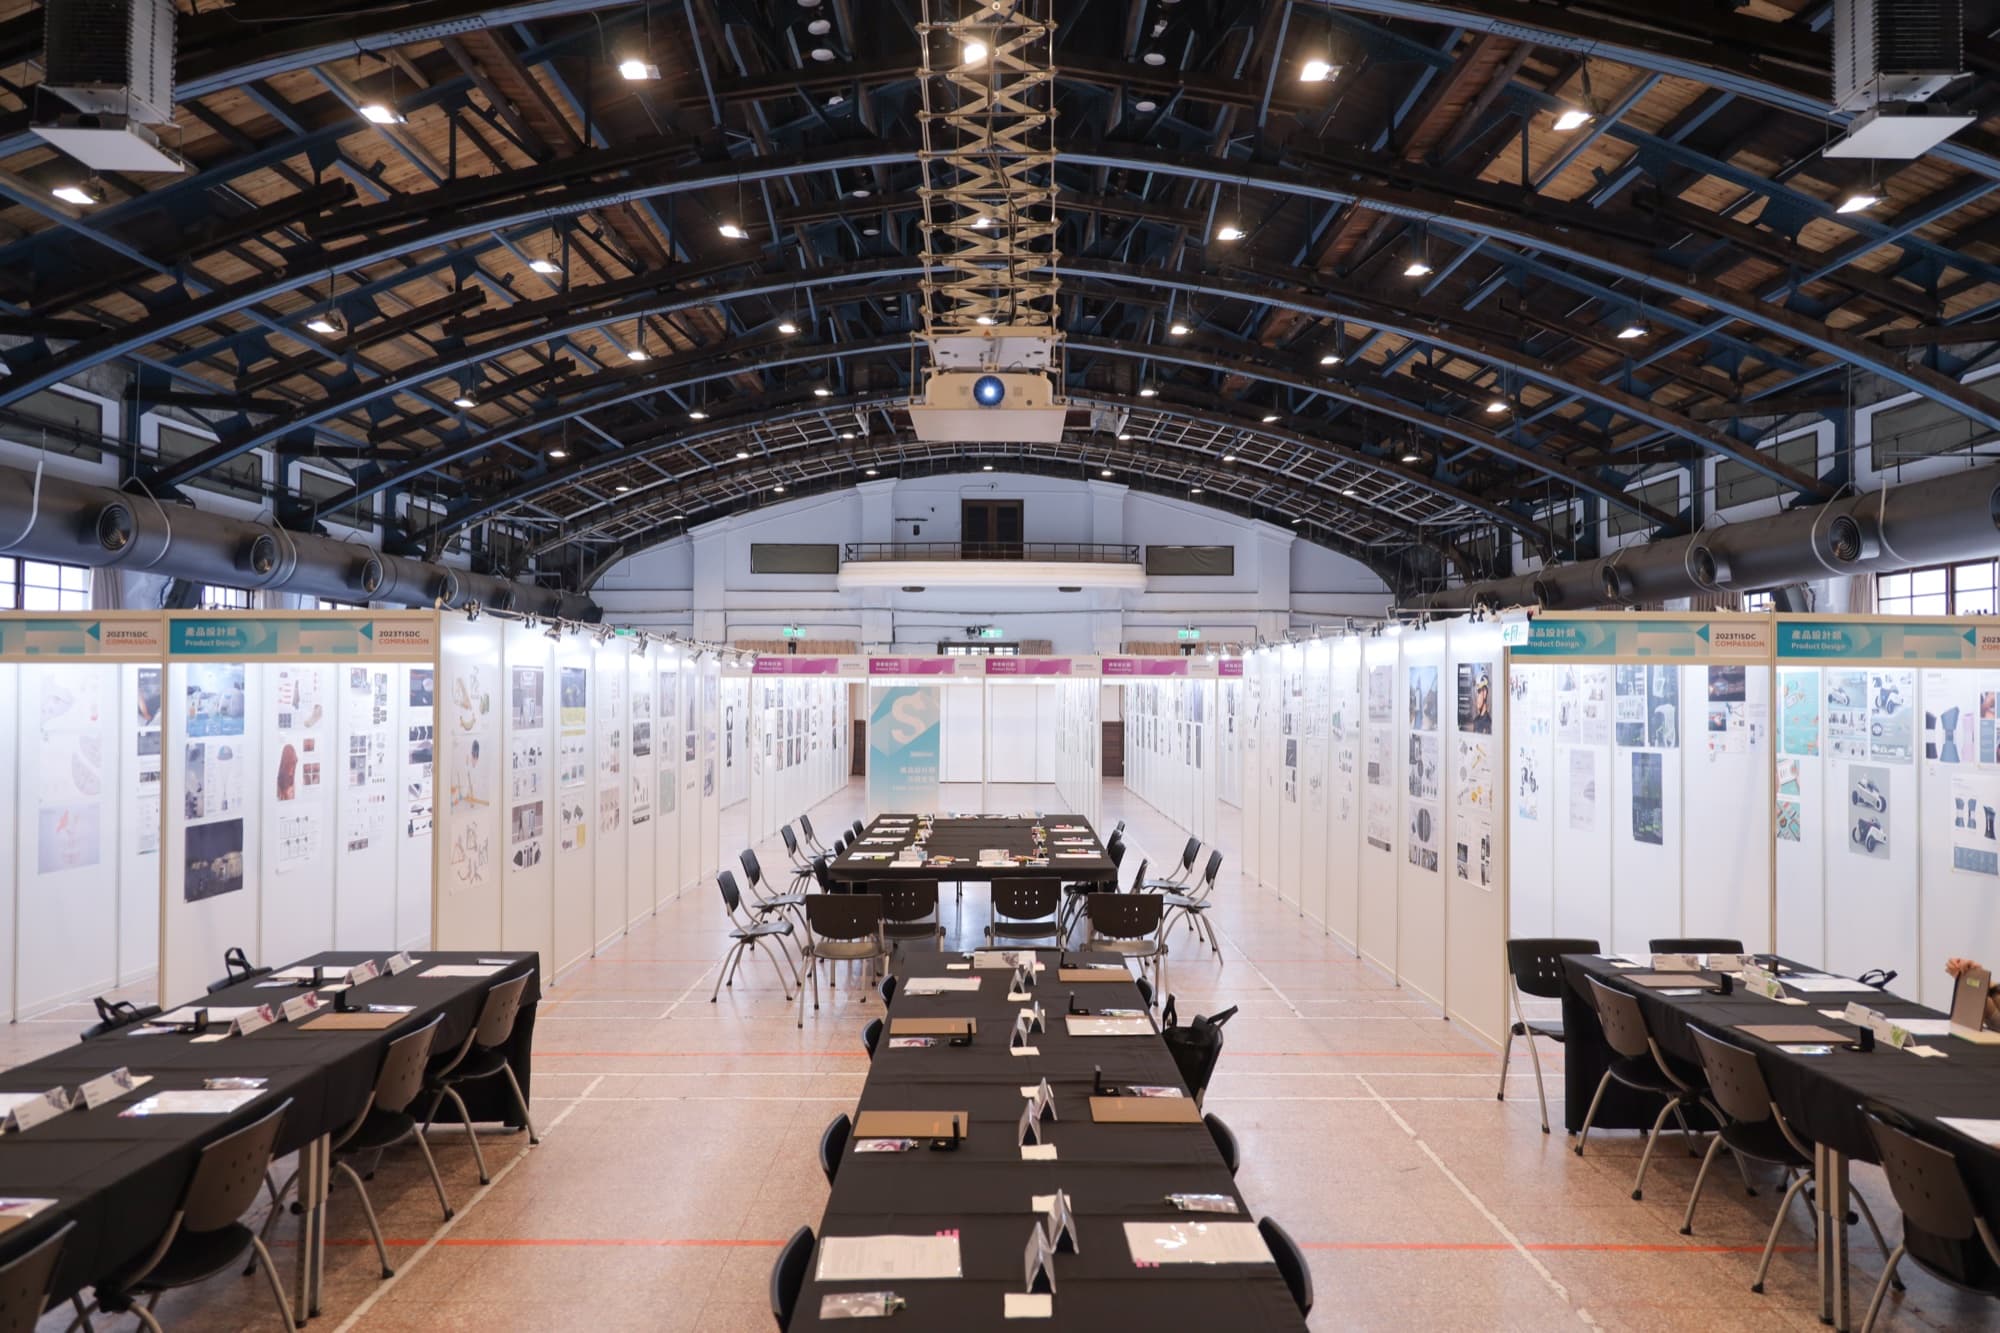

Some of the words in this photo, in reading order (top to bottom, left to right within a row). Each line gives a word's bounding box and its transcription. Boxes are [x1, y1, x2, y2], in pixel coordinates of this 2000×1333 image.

[185, 639, 215, 647] Product
[216, 639, 240, 648] Design
[1555, 640, 1580, 649] Design
[1715, 640, 1765, 648] COMPASSION
[1821, 642, 1846, 651] Design
